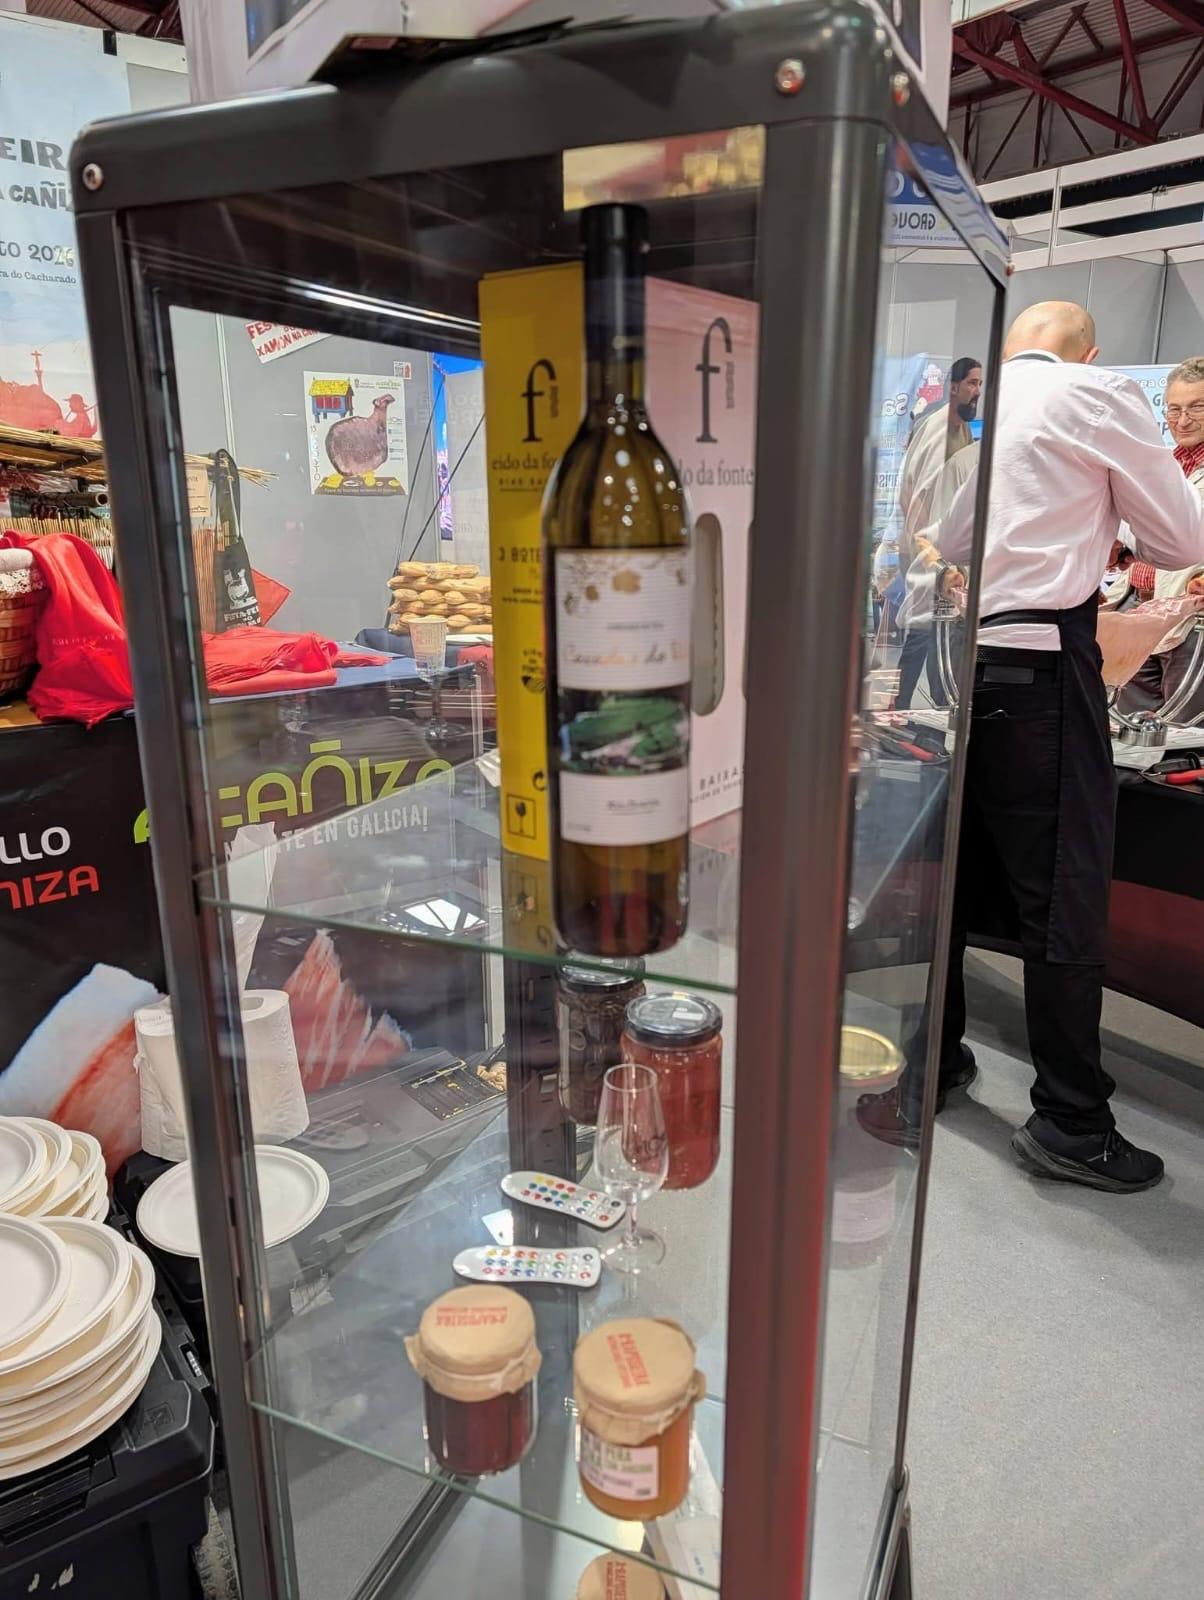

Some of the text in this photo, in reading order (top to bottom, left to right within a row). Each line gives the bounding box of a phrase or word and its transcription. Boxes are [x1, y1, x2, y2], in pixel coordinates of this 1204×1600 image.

[28, 244, 75, 267] 2026
[11, 269, 23, 279] do
[24, 271, 77, 284] Cacharado
[694, 317, 733, 443] f
[521, 358, 557, 443] f
[696, 460, 716, 487] da
[717, 460, 755, 487] fonte
[312, 821, 339, 845] EN
[346, 803, 430, 839] GALICIA!
